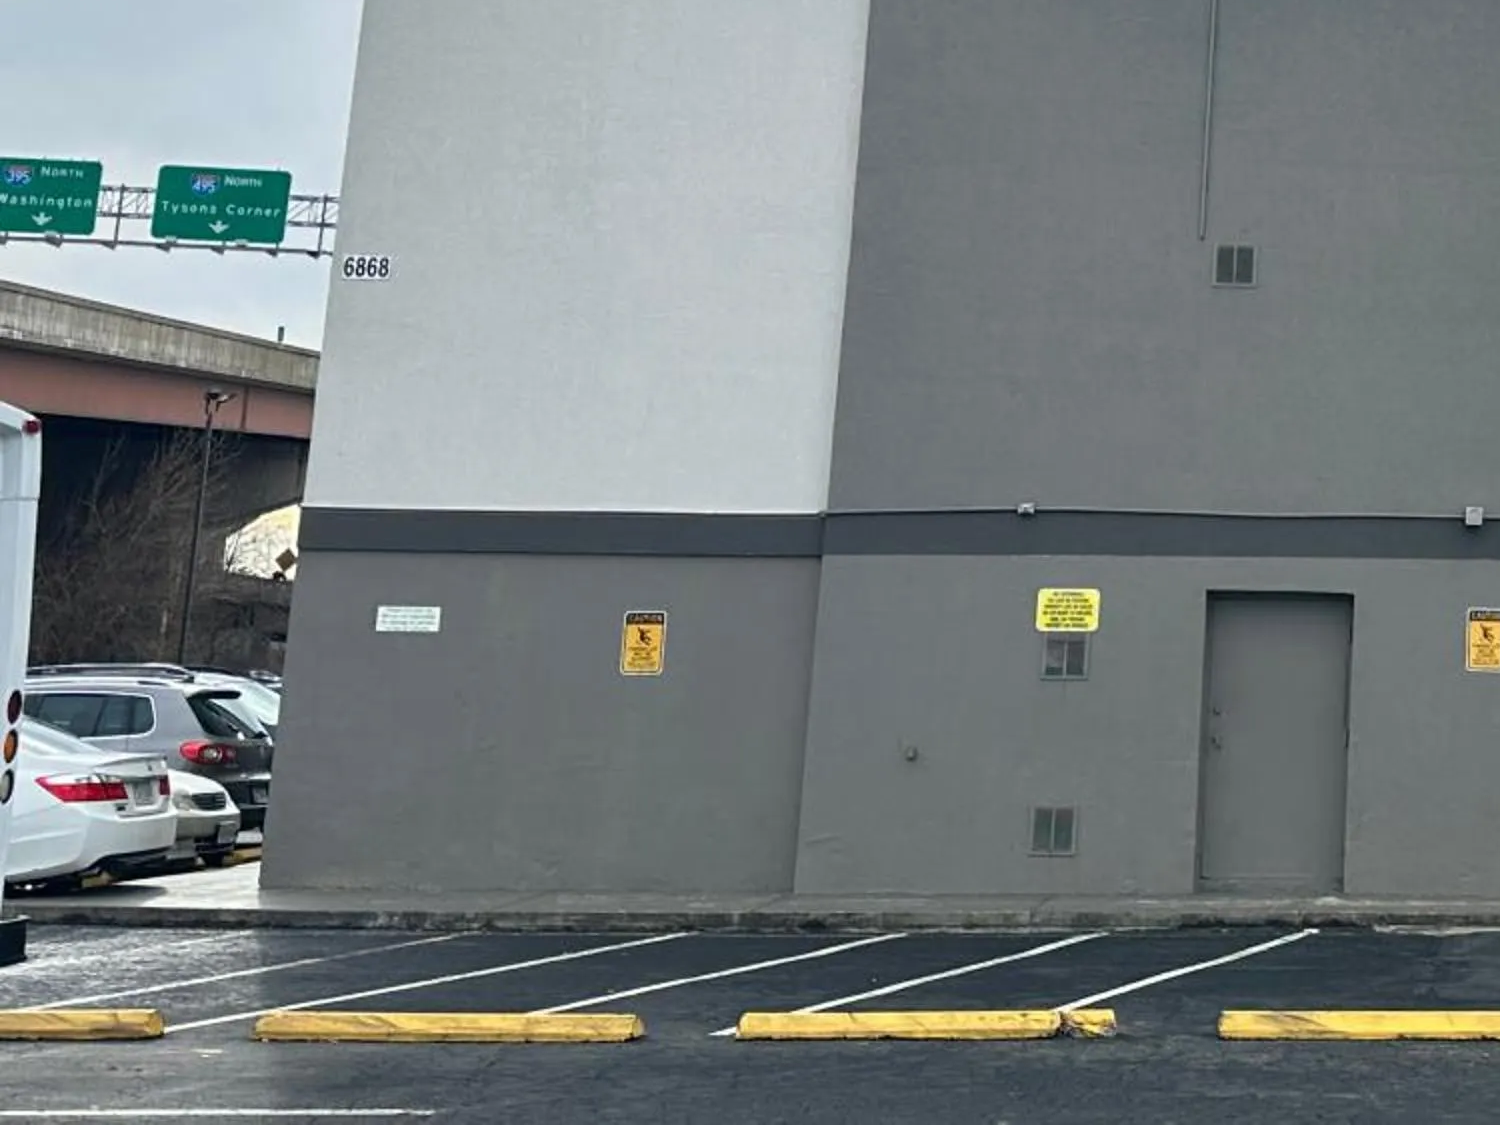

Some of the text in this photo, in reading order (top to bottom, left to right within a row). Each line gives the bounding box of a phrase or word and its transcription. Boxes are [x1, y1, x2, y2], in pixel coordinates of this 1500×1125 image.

[0, 193, 92, 210] Washington
[162, 201, 281, 218] Tysons Corner
[343, 256, 389, 277] 6868
